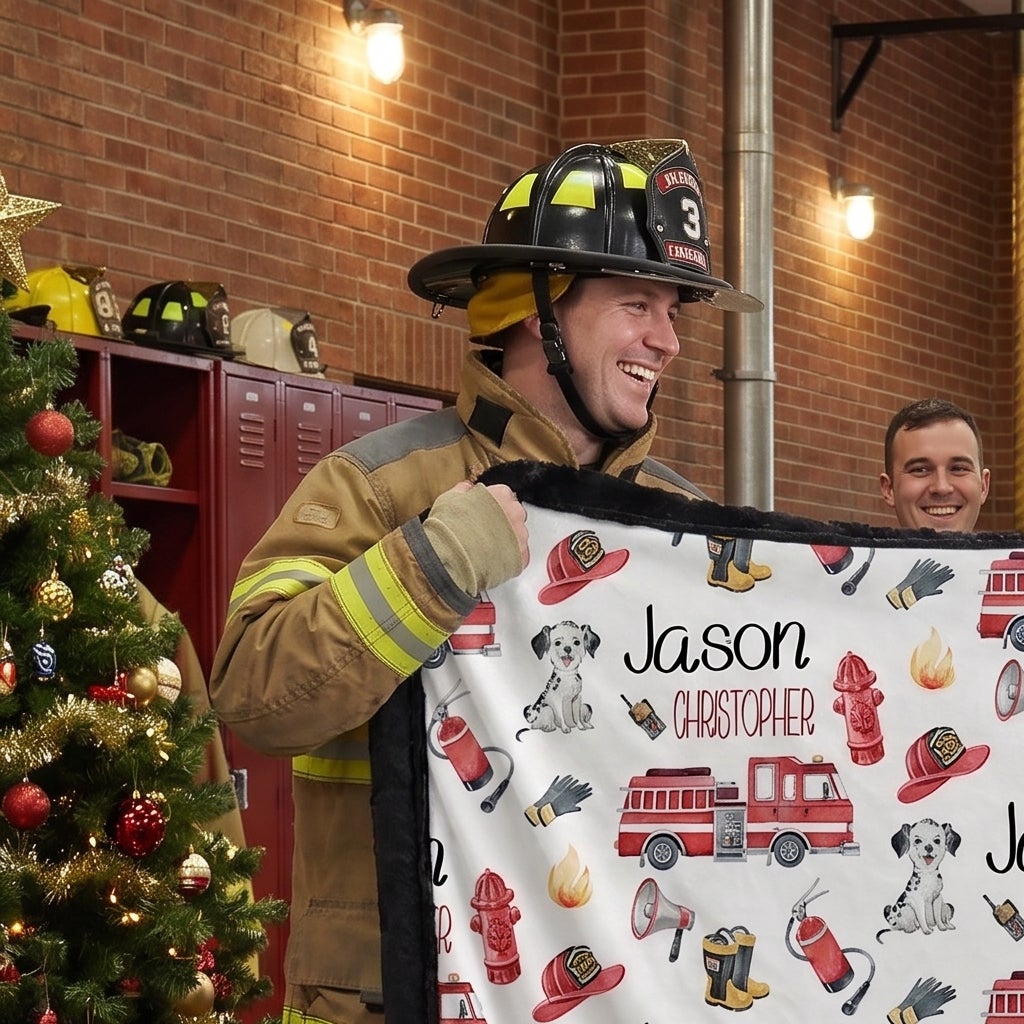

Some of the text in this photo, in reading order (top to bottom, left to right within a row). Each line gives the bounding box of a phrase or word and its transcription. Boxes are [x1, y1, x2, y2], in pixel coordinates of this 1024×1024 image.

[681, 197, 701, 240] 3
[624, 604, 810, 674] Jason
[674, 688, 814, 739] CHRISTOPHER
